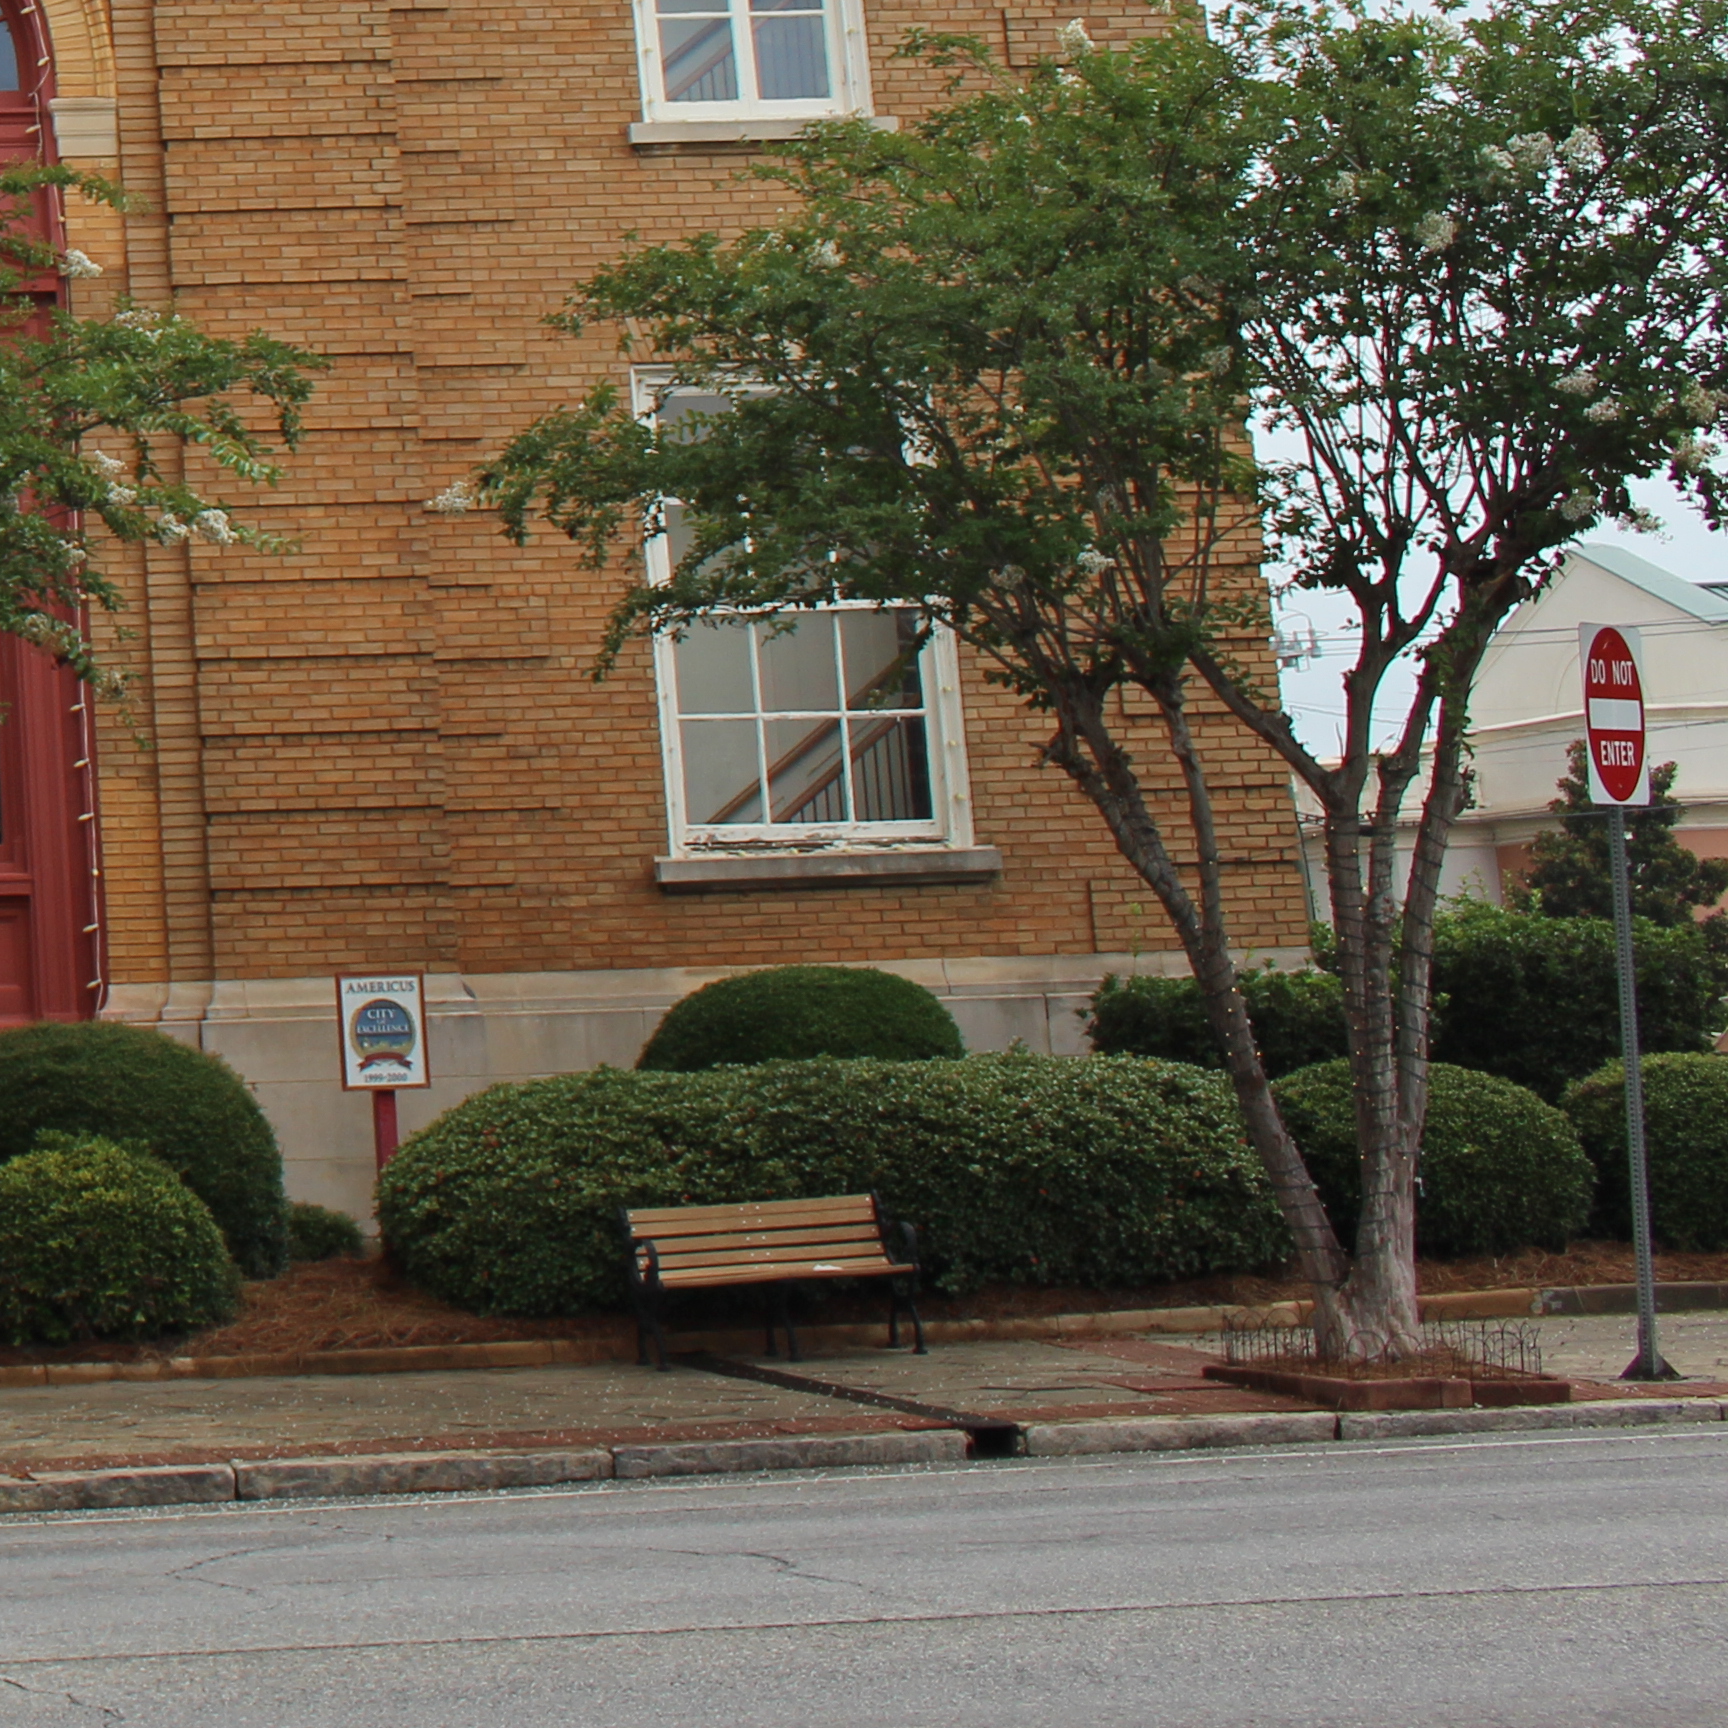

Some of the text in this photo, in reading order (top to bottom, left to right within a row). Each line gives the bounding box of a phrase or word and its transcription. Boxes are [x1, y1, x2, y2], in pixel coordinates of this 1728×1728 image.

[1590, 658, 1633, 686] DO NOT
[1600, 739, 1635, 767] ENTER
[346, 980, 416, 993] AMERICUS
[366, 1008, 396, 1020] CITY
[356, 1024, 410, 1034] EXCELLENCE
